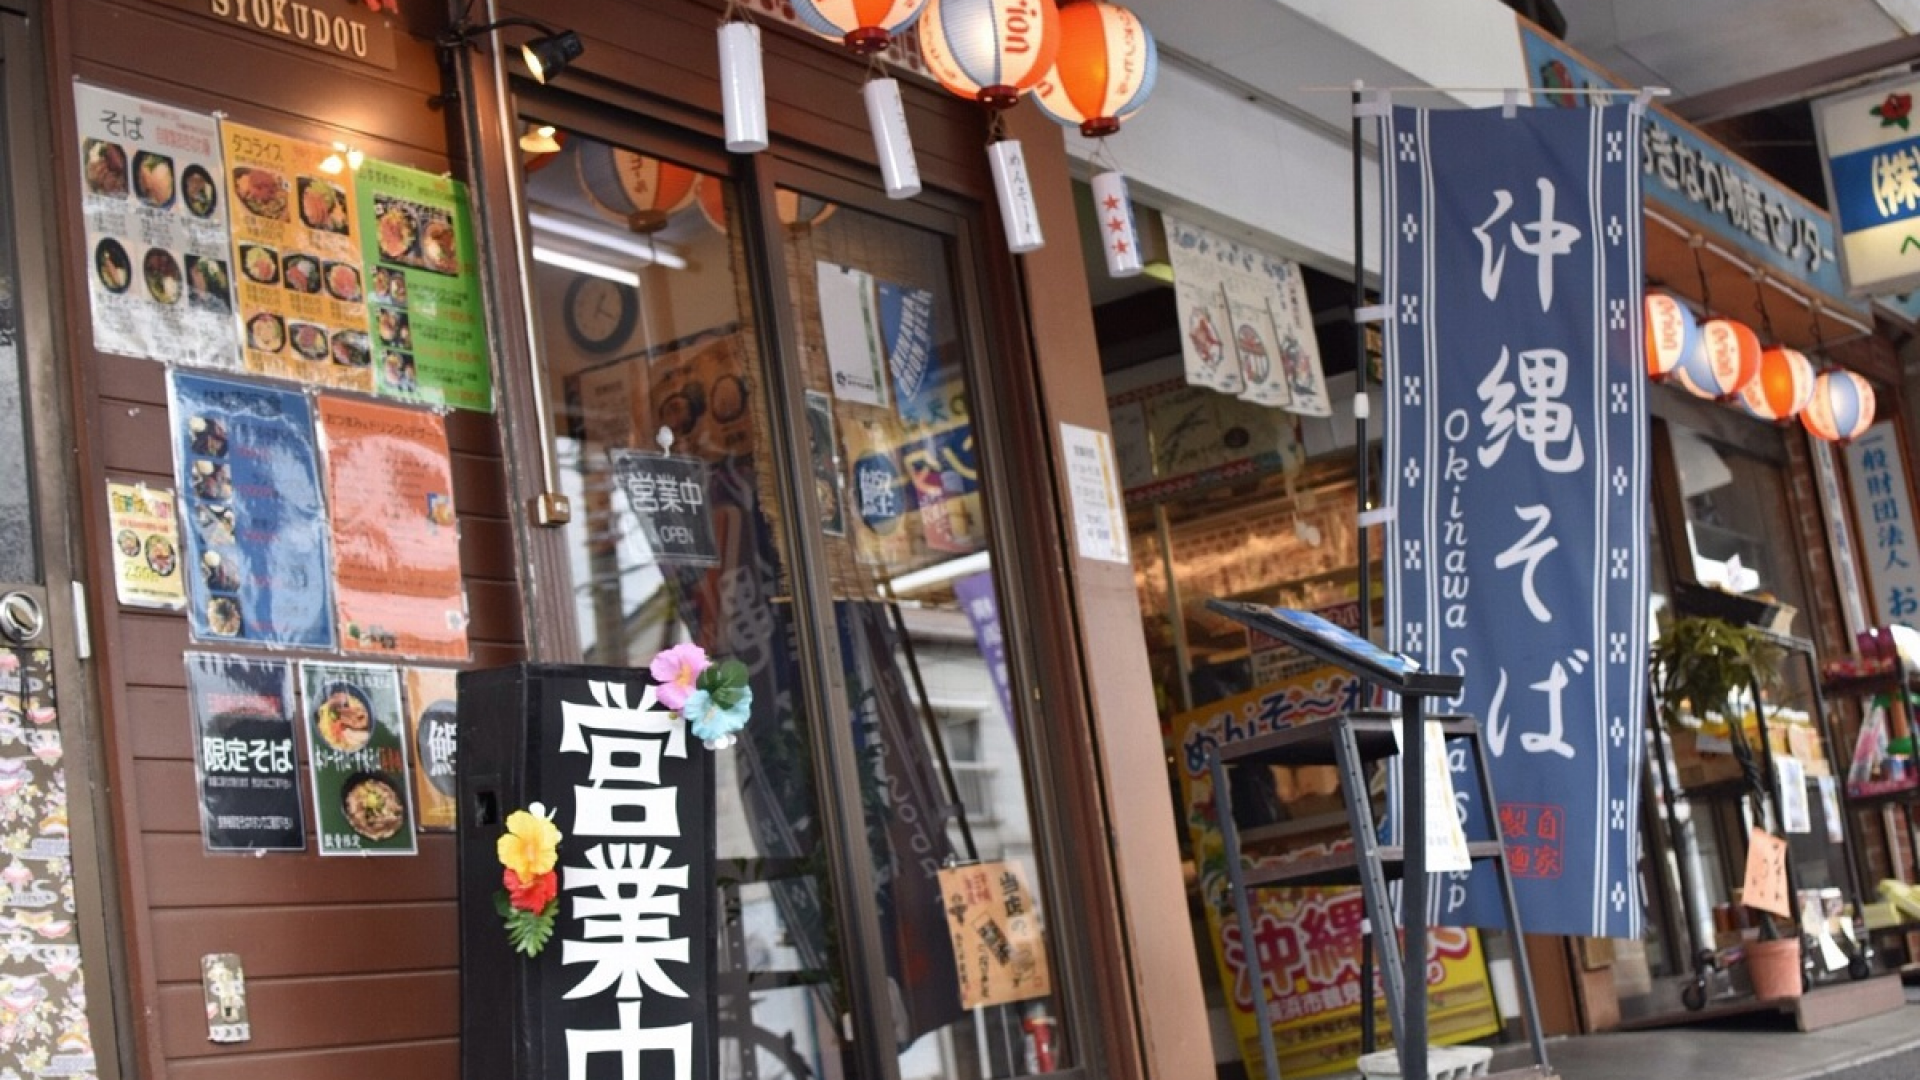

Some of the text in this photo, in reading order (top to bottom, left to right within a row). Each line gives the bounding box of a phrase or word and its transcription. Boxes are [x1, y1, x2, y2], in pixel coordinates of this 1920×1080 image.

[1004, 0, 1037, 54] ion
[99, 110, 145, 141] そば
[232, 133, 283, 162] タコライス
[1643, 122, 1835, 272] きなわ物産センター
[627, 472, 703, 515] 営業中
[1472, 177, 1590, 760] 沖縄そば
[1859, 434, 1909, 571] 一般財団法人
[660, 526, 695, 545] OPEN
[1443, 409, 1470, 628] Okinawa
[202, 736, 294, 774] 限定そば
[1448, 648, 1468, 773] Soa
[559, 680, 693, 1080] 営業中
